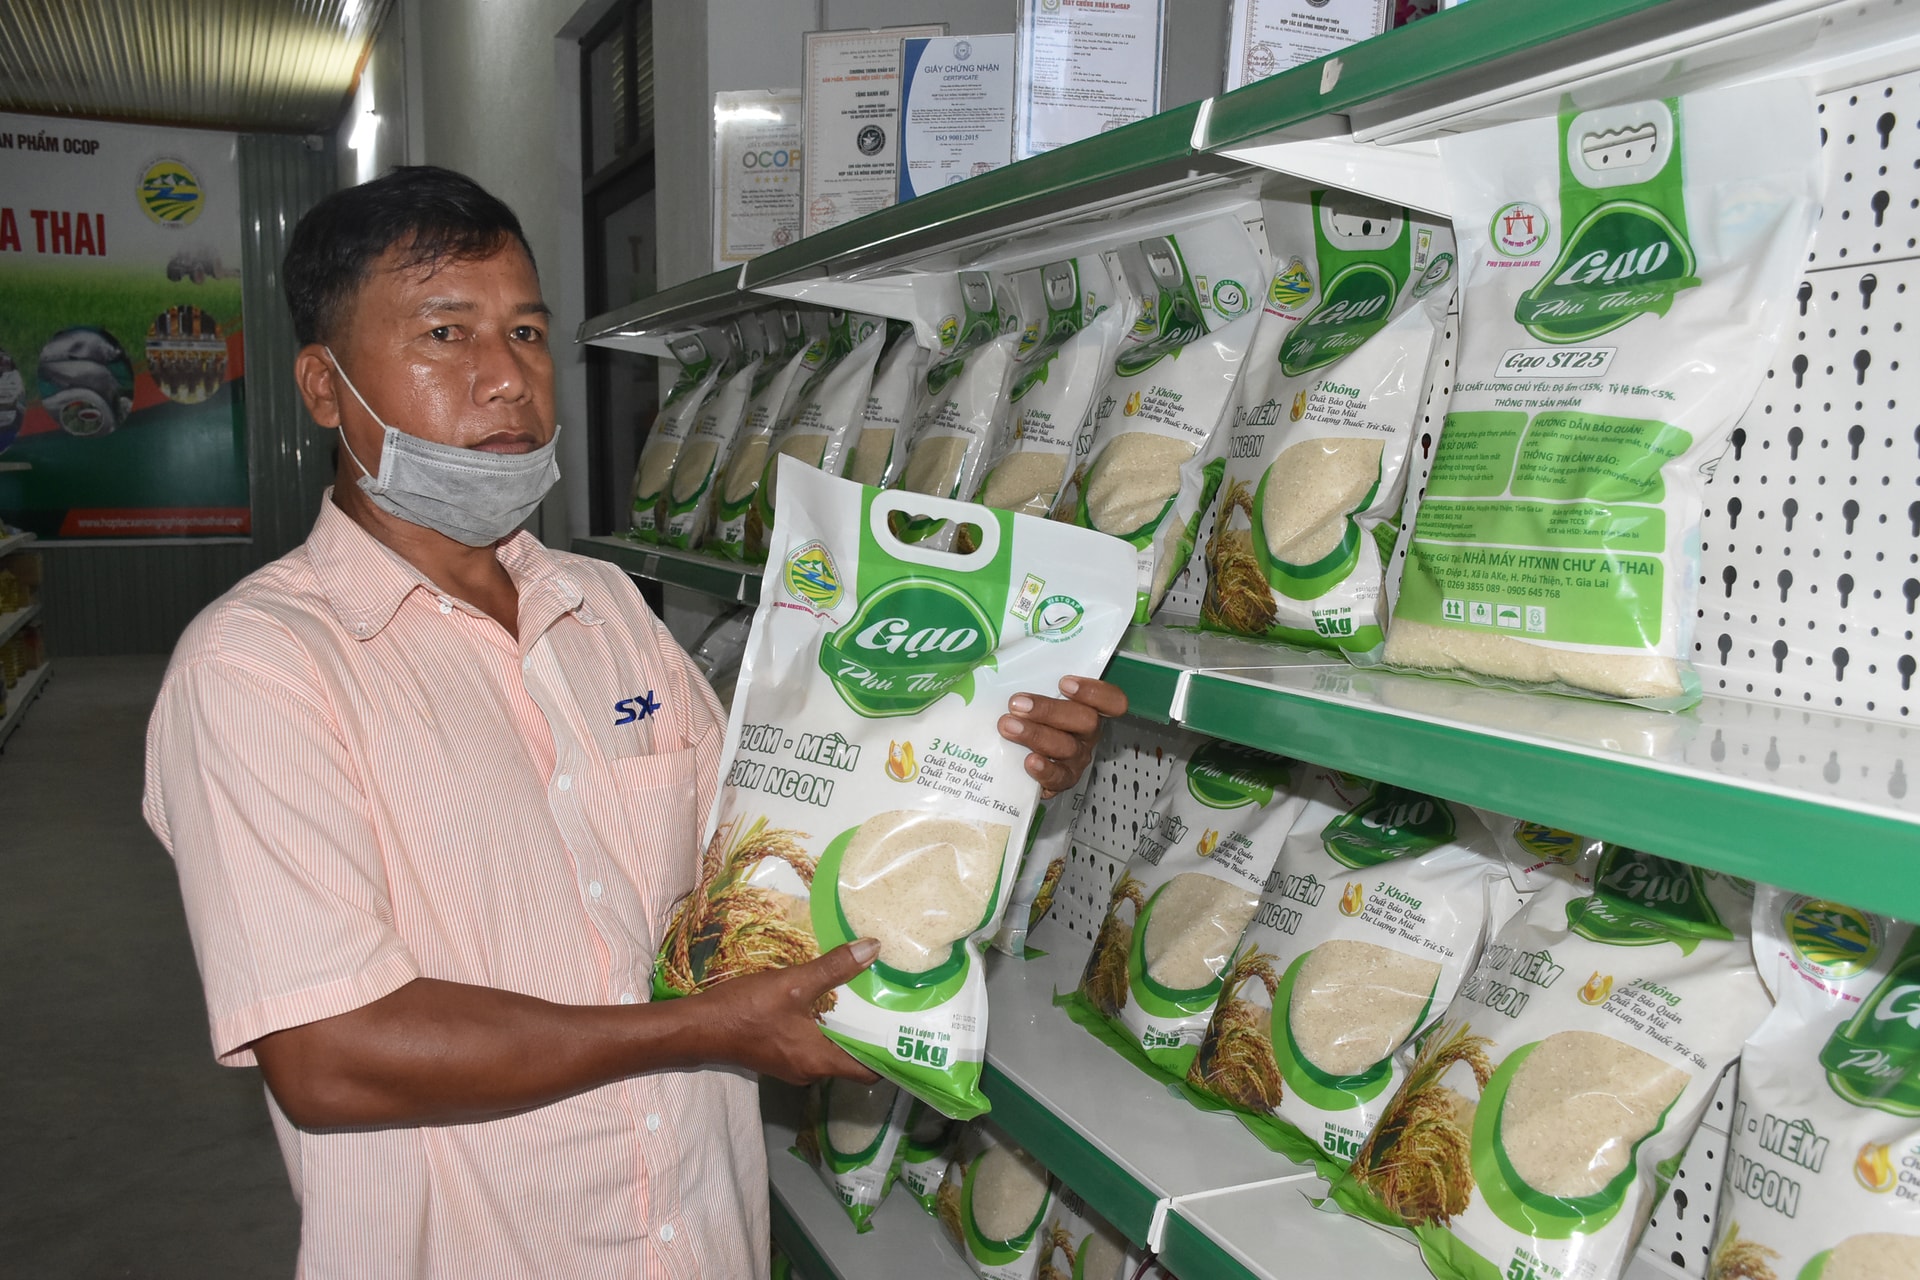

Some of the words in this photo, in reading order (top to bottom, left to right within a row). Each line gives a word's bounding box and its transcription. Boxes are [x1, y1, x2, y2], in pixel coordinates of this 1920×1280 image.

[924, 64, 943, 73] GIẤY
[945, 63, 975, 73] CHỨNG
[977, 64, 999, 72] NHẬN
[18, 130, 59, 152] PHẨM
[63, 138, 99, 155] OCOP
[743, 150, 800, 168] OCOP
[30, 210, 106, 256] THAI
[1554, 241, 1669, 285] Gạo
[1308, 294, 1387, 326] Gạo
[1530, 298, 1590, 320] Phú
[1505, 352, 1546, 373] Gạo
[1546, 352, 1609, 368] ST25
[1310, 394, 1326, 403] Chất
[1328, 396, 1344, 406] Bảo
[1346, 400, 1367, 410] Quản
[1314, 380, 1322, 391] 3
[1322, 381, 1361, 399] Không
[1465, 382, 1483, 392] CHẤT
[1484, 382, 1512, 394] LƯỢNG
[1514, 382, 1531, 393] CHỦ
[1533, 382, 1551, 392] YẾU:
[1620, 385, 1629, 395] lệ
[1307, 403, 1325, 412] Chất
[1327, 406, 1340, 416] Tạo
[1341, 409, 1358, 418] Mùi
[1494, 398, 1523, 408] THÔNG
[1525, 398, 1538, 408] TIN
[1540, 398, 1554, 408] SẢN
[1556, 398, 1581, 408] PHẨM
[1317, 415, 1341, 425] Lượng
[1343, 418, 1365, 428] Thuốc
[1380, 424, 1396, 433] Sâu
[1535, 419, 1566, 428] HƯỚNG
[1569, 418, 1590, 431] DẪN
[1592, 423, 1612, 433] BẢO
[1614, 424, 1644, 434] QUẢN:
[1446, 442, 1456, 450] SỬ
[1456, 442, 1478, 450] DỤNG:
[1523, 450, 1553, 460] THÔNG
[1556, 455, 1569, 463] TIN
[1570, 453, 1594, 462] CẢNH
[1595, 455, 1620, 465] BÁO:
[1463, 549, 1487, 564] NHÀ
[1488, 551, 1516, 566] MÁY
[1518, 556, 1560, 570] HTXNN
[1562, 558, 1596, 572] CHƯ
[1600, 559, 1611, 573] A
[1617, 560, 1654, 576] THAI
[1432, 566, 1445, 575] Tân
[1446, 567, 1462, 578] Điệp
[1463, 569, 1470, 578] 1,
[1471, 569, 1481, 578] Xã
[1490, 571, 1508, 581] AKe,
[1511, 572, 1518, 582] H.
[1521, 572, 1537, 582] Phú
[1539, 576, 1563, 586] Thiện,
[1566, 578, 1574, 586] T.
[1576, 577, 1592, 587] Gia
[1595, 578, 1609, 588] Lai
[1447, 580, 1464, 590] 0269
[1466, 582, 1485, 591] 3855
[1486, 583, 1500, 592] 089
[1507, 584, 1526, 595] 0905
[1528, 587, 1544, 596] 645
[1545, 588, 1560, 598] 768
[1046, 596, 1080, 609] VIETGAP
[855, 617, 978, 659] Gạo
[1315, 617, 1351, 634] 5kg
[837, 658, 896, 691] Phú
[795, 732, 861, 772] MỀM
[929, 738, 941, 750] 3
[942, 741, 988, 768] Không
[920, 765, 943, 779] Chất
[945, 772, 961, 784] Tạo
[962, 778, 983, 792] Mùi
[924, 754, 946, 768] Chất
[948, 761, 967, 774] Bảo
[968, 768, 994, 783] Quản
[763, 766, 834, 807] NGON
[917, 776, 933, 787] Dư
[932, 781, 962, 798] Lượng
[964, 790, 991, 806] Thuốc
[1007, 806, 1020, 818] Sâu
[1281, 874, 1325, 907] MỀM
[1375, 882, 1385, 892] 3
[1384, 885, 1423, 910] Không
[1258, 902, 1302, 935] NGON
[1364, 903, 1383, 916] Chất
[1383, 910, 1397, 923] Tạo
[1398, 916, 1415, 930] Mùi
[1369, 894, 1387, 907] Chất
[1387, 900, 1403, 913] Bảo
[1404, 908, 1426, 924] Quản
[1372, 917, 1397, 934] Lượng
[1398, 928, 1422, 944] Thuốc
[1510, 950, 1564, 988] MỀM
[1618, 986, 1637, 999] Chất
[1637, 993, 1655, 1008] Bảo
[1656, 1002, 1682, 1024] Quản
[1628, 977, 1641, 987] 3
[1637, 980, 1682, 1007] Không
[1609, 993, 1630, 1009] Chất
[1631, 1002, 1646, 1017] Tạo
[1648, 1012, 1668, 1030] Mùi
[898, 1025, 914, 1035] Khối
[916, 1028, 935, 1039] Lượng
[938, 1031, 951, 1042] Tịnh
[1615, 1008, 1644, 1030] Lượng
[1645, 1024, 1672, 1045] Thuốc
[1689, 1052, 1707, 1070] Sâu
[896, 1035, 948, 1067] 5kg
[1759, 1113, 1830, 1173] MỀM
[1734, 1154, 1800, 1218] NGON
